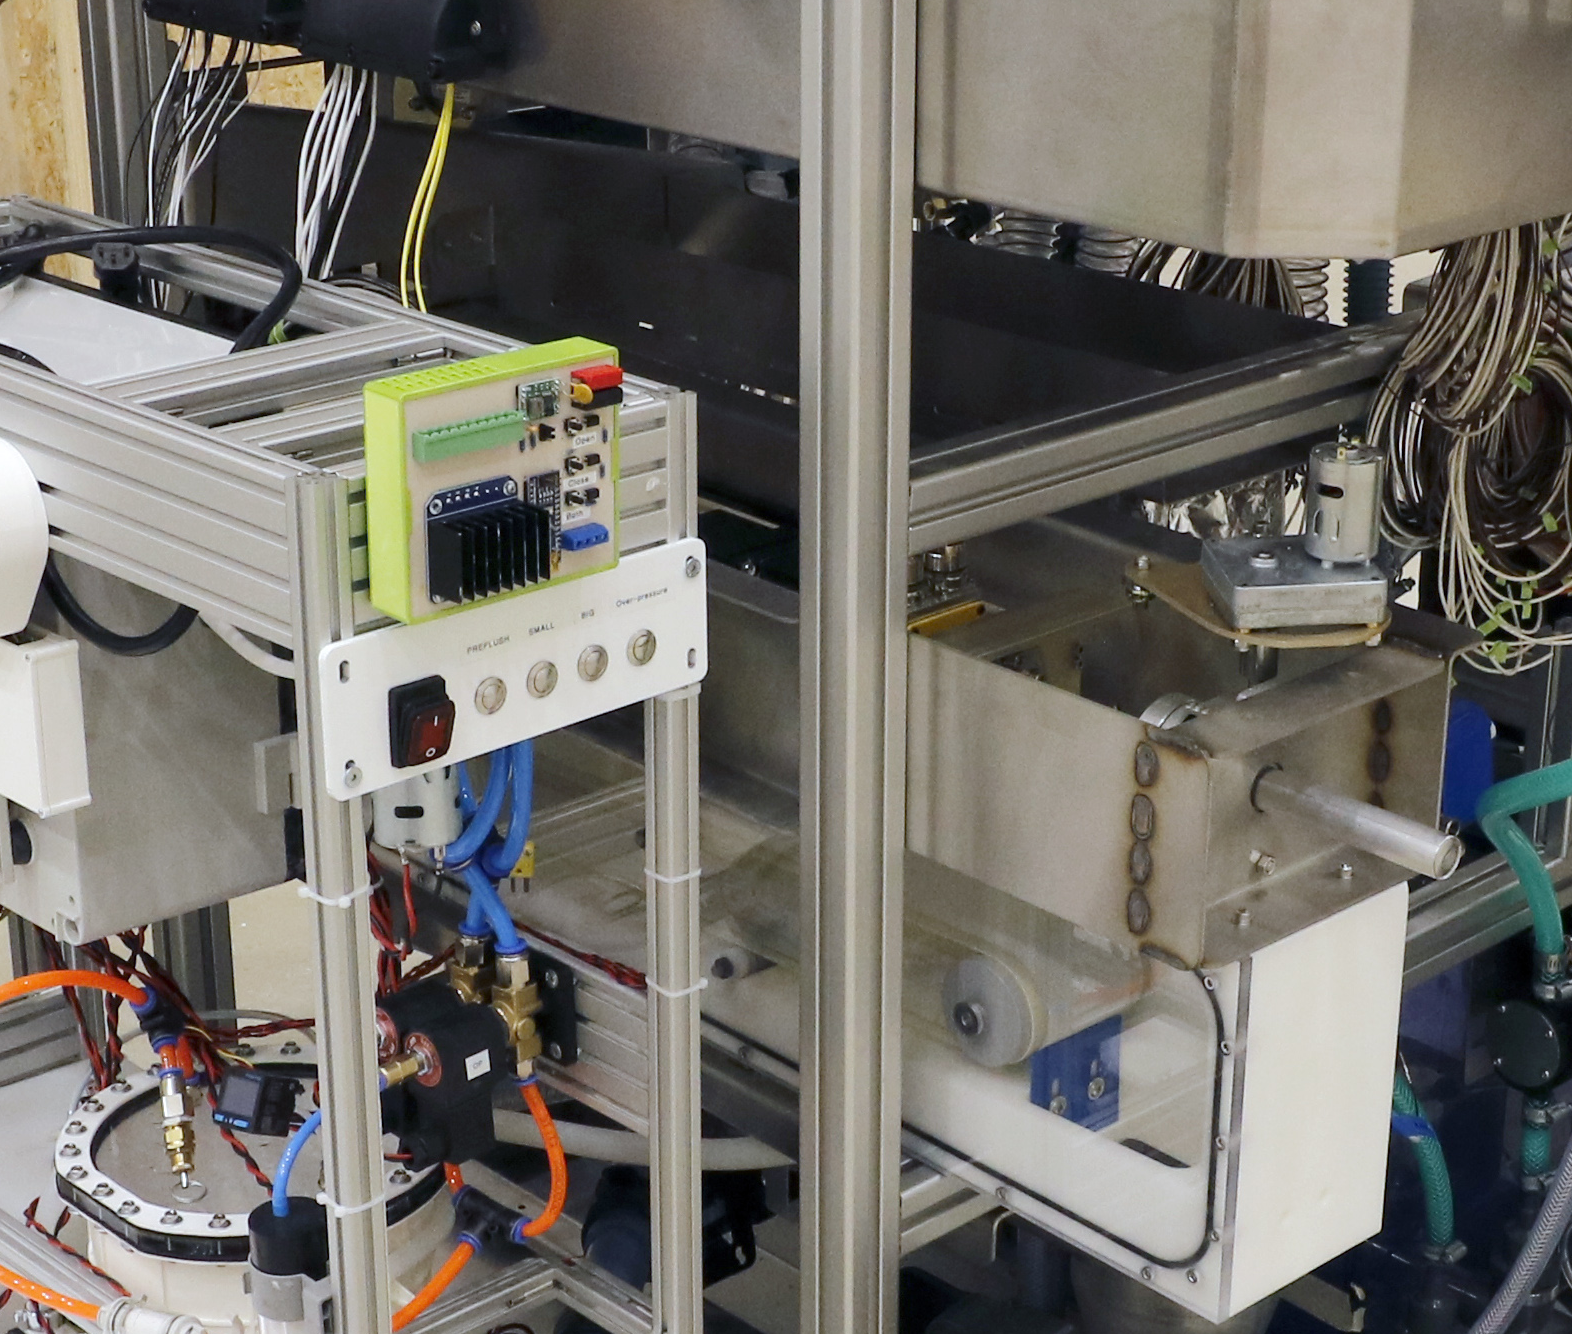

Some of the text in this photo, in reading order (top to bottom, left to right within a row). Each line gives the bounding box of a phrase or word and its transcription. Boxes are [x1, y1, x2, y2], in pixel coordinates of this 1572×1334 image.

[575, 434, 595, 446] Open
[567, 476, 589, 488] Close
[615, 587, 669, 608] Over-pressure
[580, 609, 595, 620] BIG
[528, 622, 555, 636] SMALL
[466, 634, 511, 655] PREFLUSH
